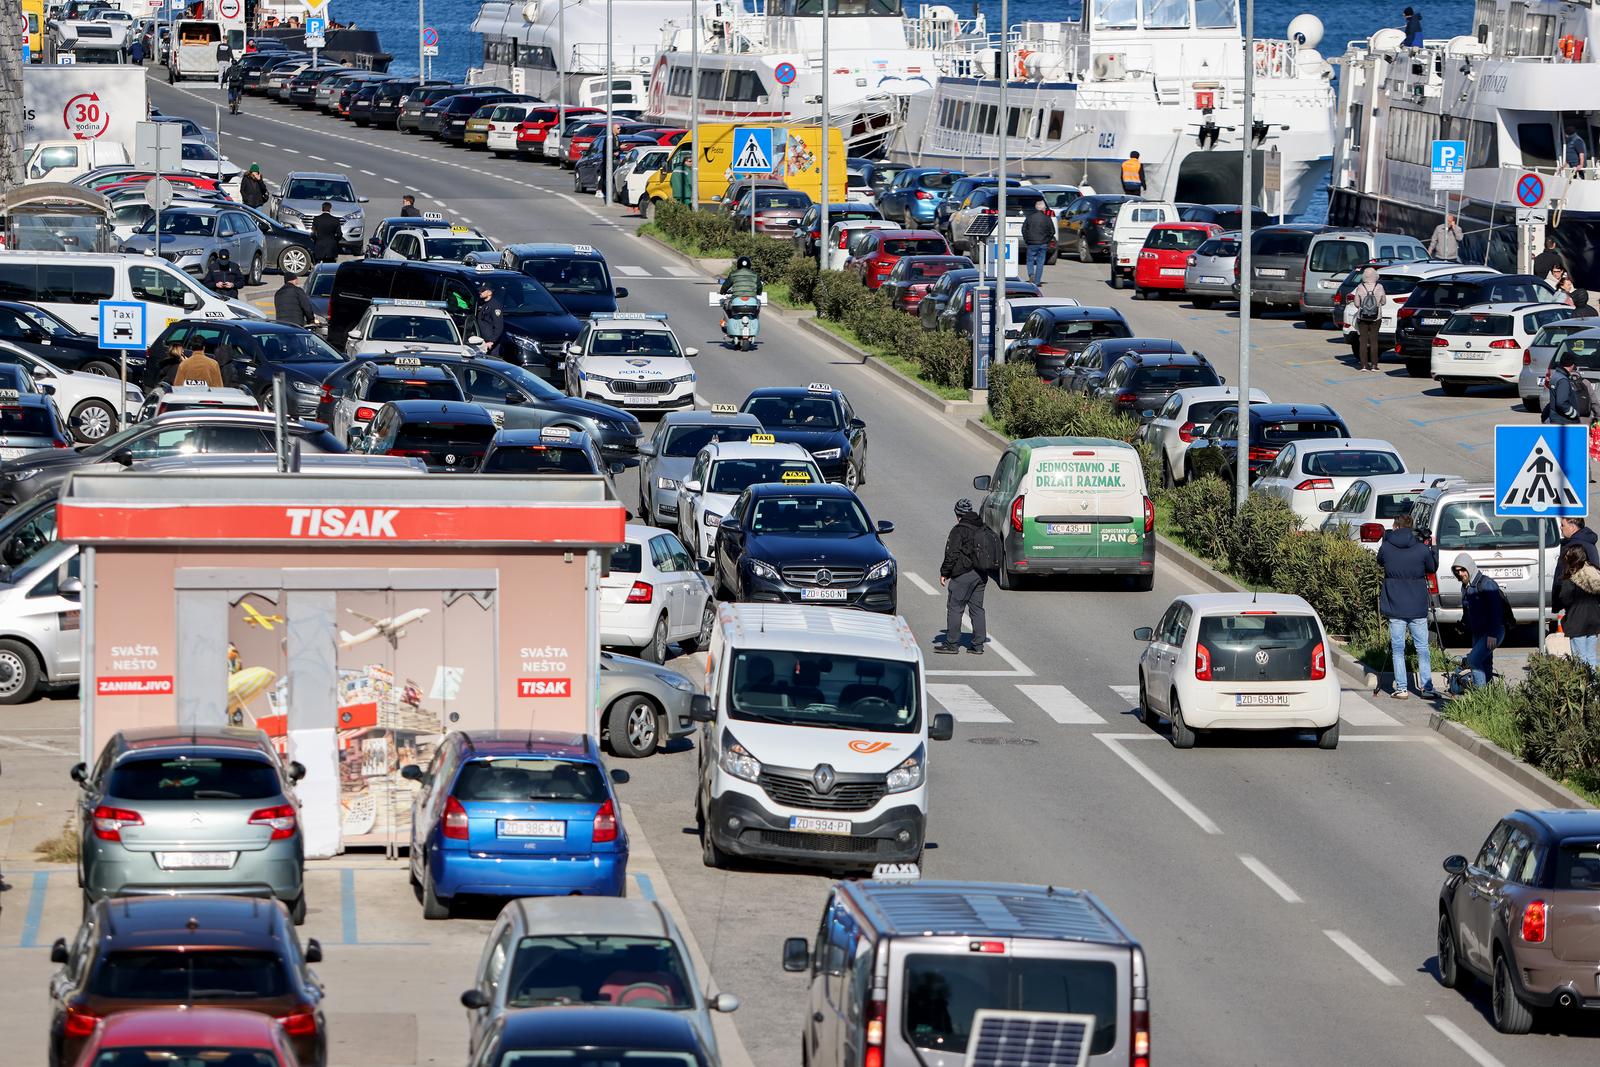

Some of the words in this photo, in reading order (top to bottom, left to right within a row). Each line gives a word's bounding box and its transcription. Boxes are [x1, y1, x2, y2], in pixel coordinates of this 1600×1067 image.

[75, 103, 100, 123] 30
[75, 123, 100, 131] godina
[1098, 132, 1116, 149] OLEA
[112, 309, 135, 319] Taxi
[1036, 462, 1105, 473] JEDNOSTAVNO
[1108, 462, 1120, 473] JE
[1077, 474, 1126, 488] RAZMAK.
[286, 508, 400, 537] TISAK
[807, 589, 816, 598] ZD
[820, 589, 846, 598] 650-NT
[111, 643, 159, 657] SVAŠTA
[520, 645, 568, 658] SVAŠTA
[113, 658, 158, 670] NEŠTO
[522, 659, 566, 672] NEŠTO
[99, 680, 172, 692] ZANIMLJIVO
[521, 681, 567, 695] TISAK
[1242, 695, 1253, 704] ZD
[1257, 695, 1288, 704] 699-MU
[505, 822, 518, 833] ZD
[526, 822, 562, 833] 986-KV
[797, 818, 808, 829] ZD
[880, 863, 915, 874] TAXI
